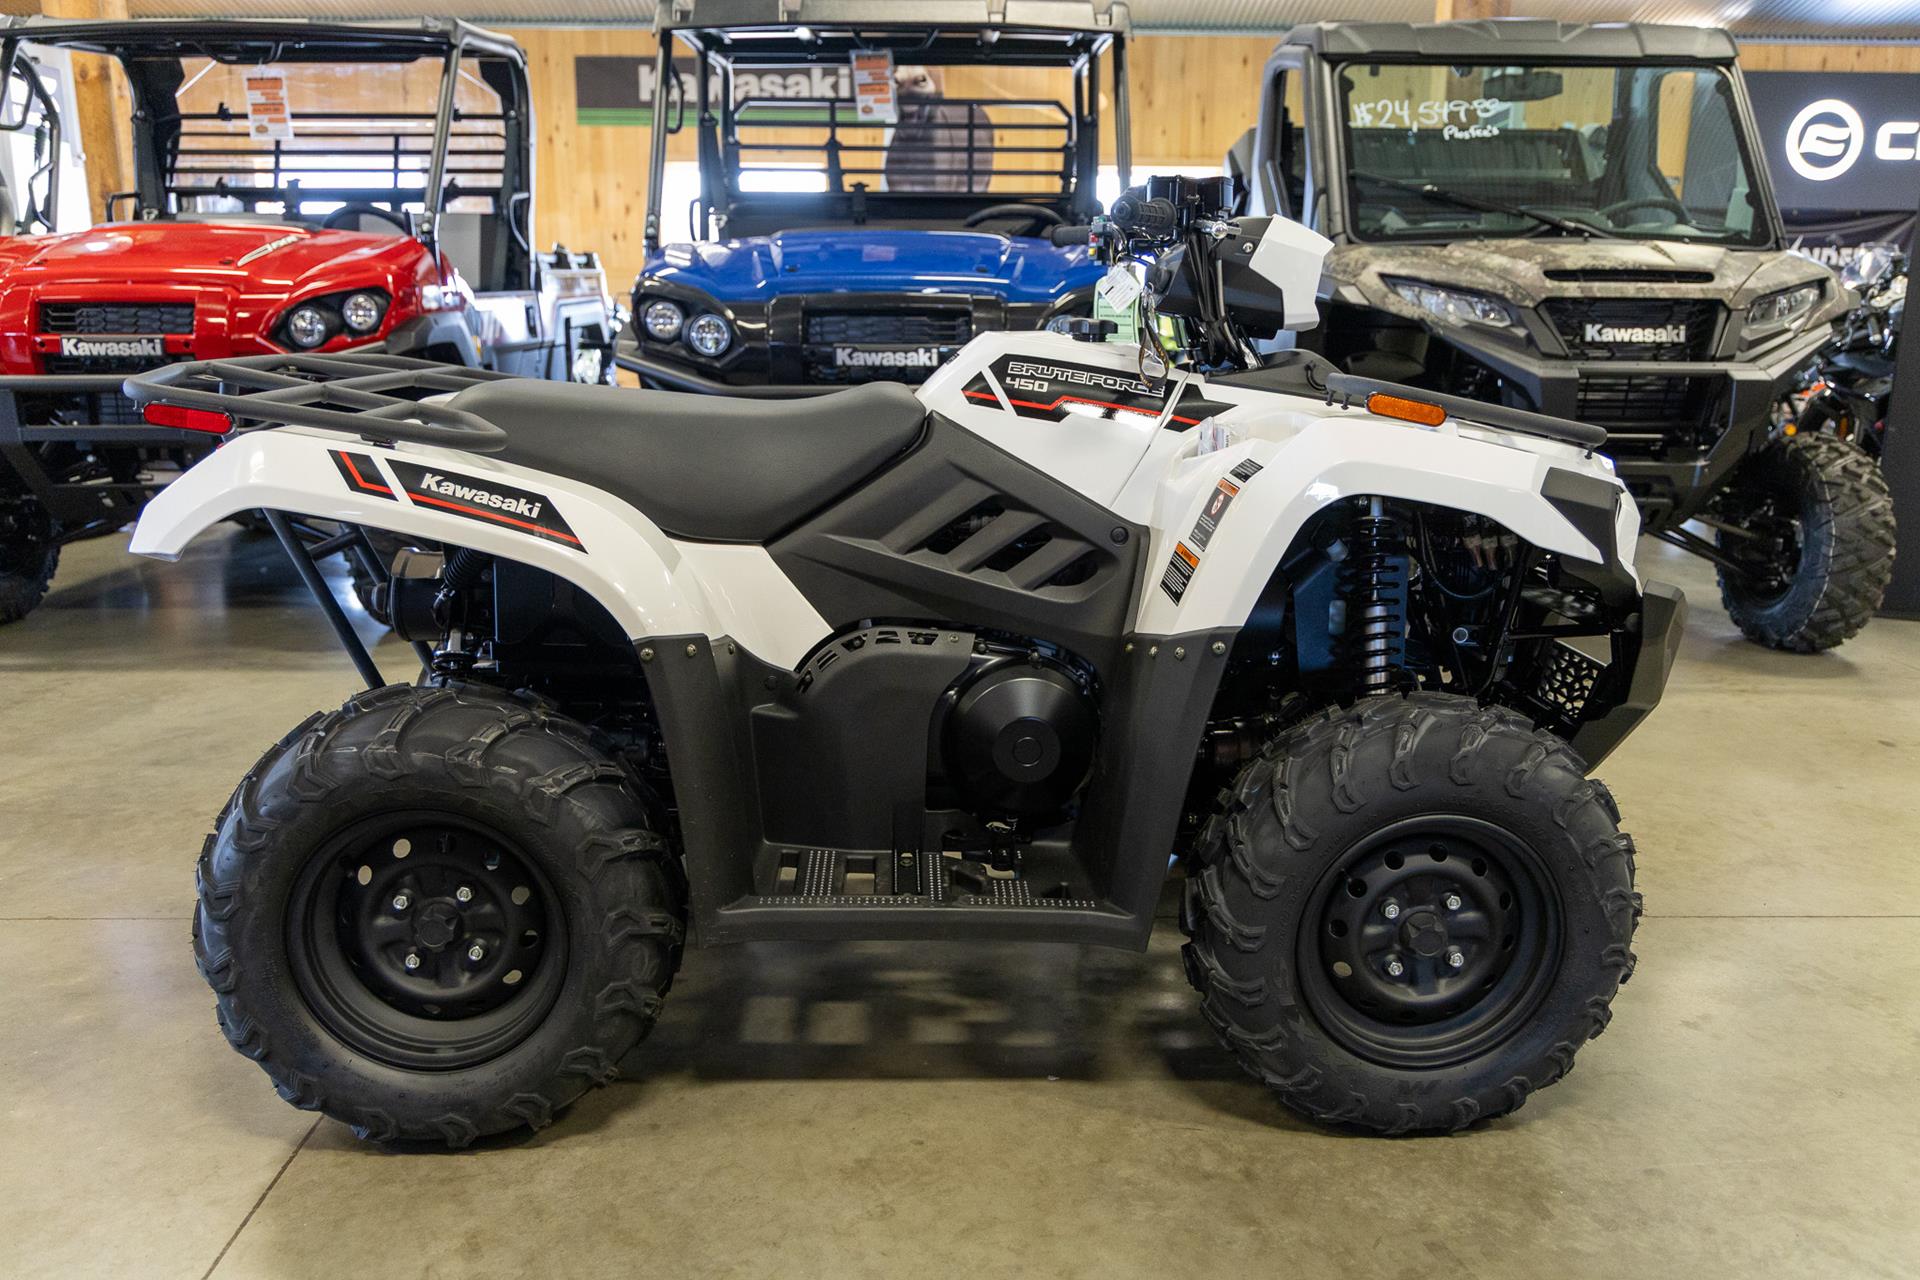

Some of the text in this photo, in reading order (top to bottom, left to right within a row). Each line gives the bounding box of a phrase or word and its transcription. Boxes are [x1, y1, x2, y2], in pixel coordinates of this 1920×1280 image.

[1874, 121, 1920, 161] C
[1584, 323, 1686, 343] Kawasaki
[61, 337, 163, 356] Kawasaki
[835, 347, 939, 367] Kawasaki
[1005, 376, 1049, 393] 450
[1007, 361, 1086, 384] BRUTE
[1086, 373, 1166, 398] FORCE
[420, 472, 542, 519] Kawasaki
